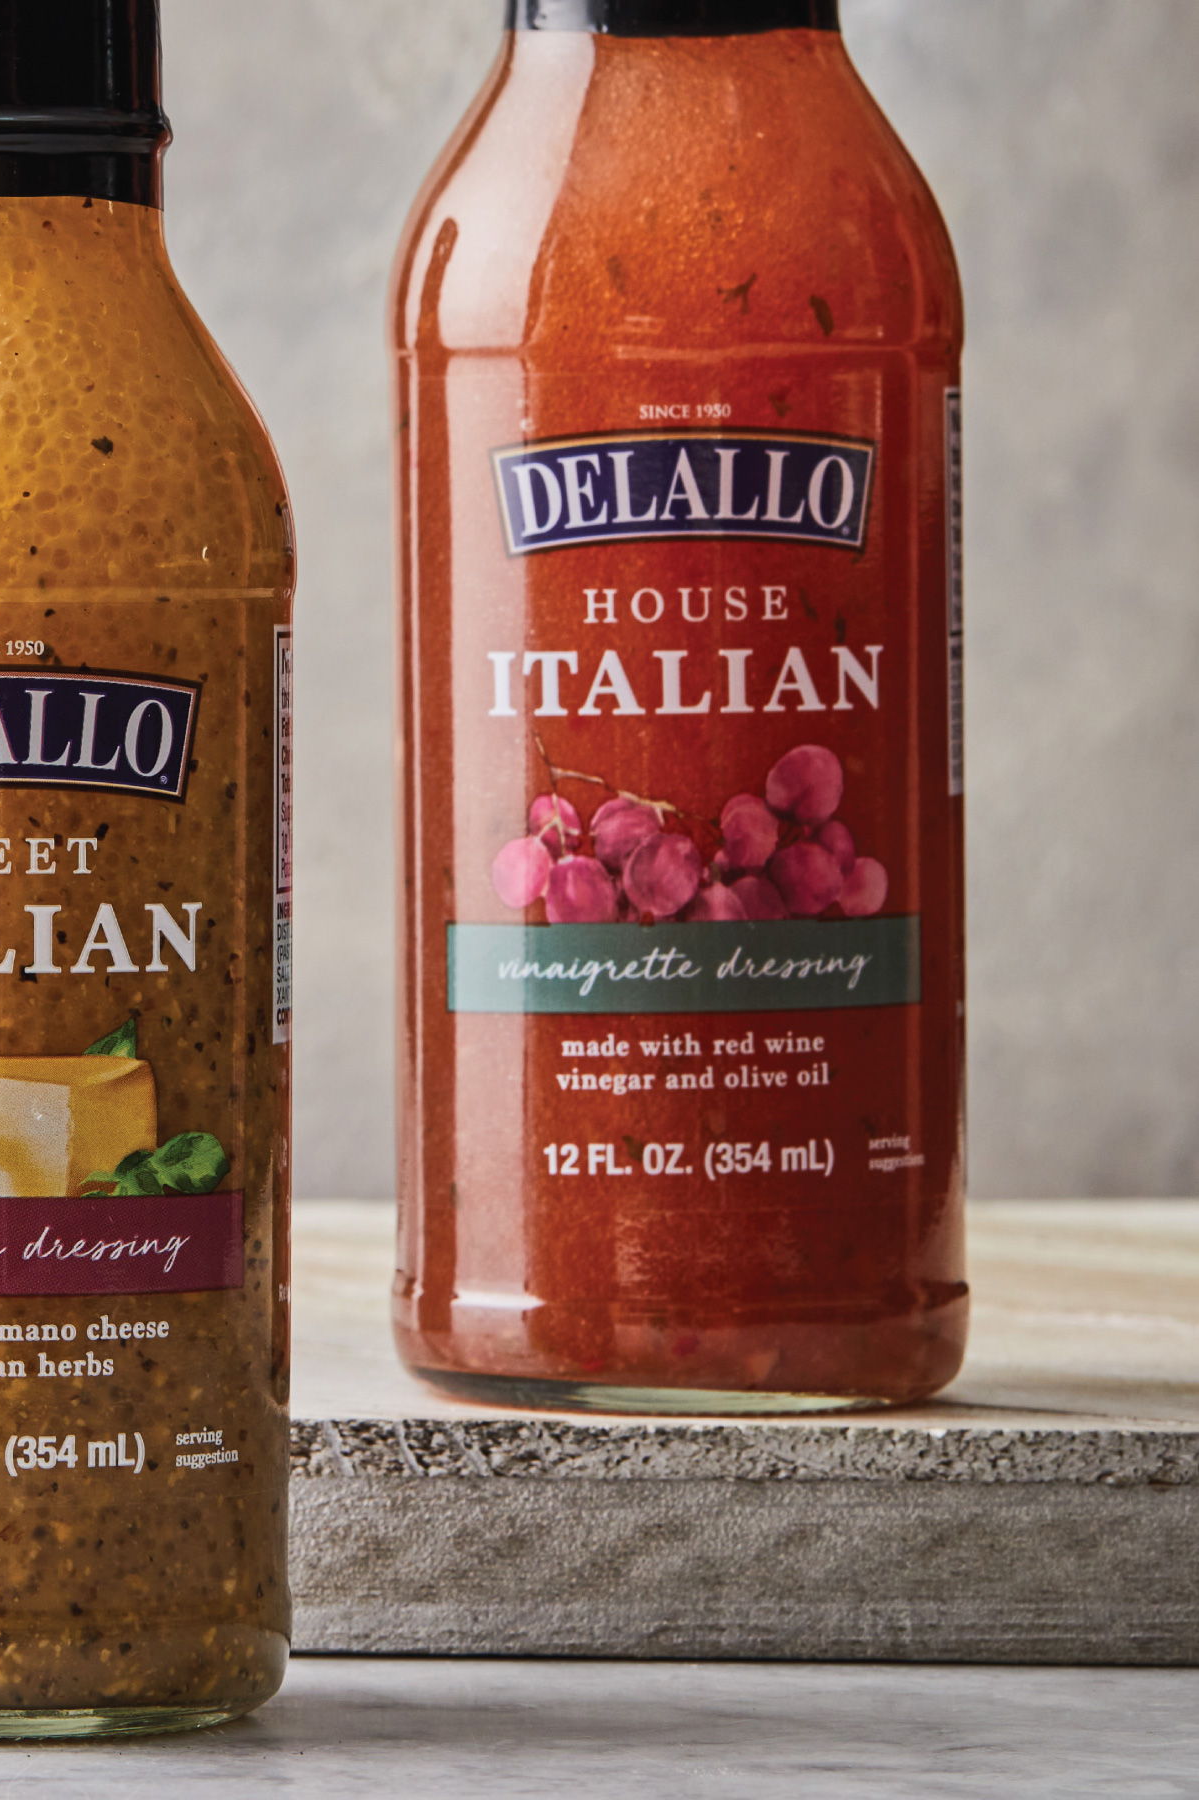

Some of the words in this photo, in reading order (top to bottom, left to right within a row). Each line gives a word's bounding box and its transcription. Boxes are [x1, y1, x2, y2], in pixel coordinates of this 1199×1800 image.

[639, 404, 690, 419] SINCE
[697, 403, 731, 418] 1950
[511, 448, 854, 537] DELALLO
[582, 586, 789, 623] HOUSE
[5, 640, 44, 655] 1950
[487, 645, 883, 716] ITALIAN
[498, 947, 701, 996] vinaigrette
[717, 947, 871, 990] dressing
[561, 1035, 629, 1057] made
[639, 1034, 701, 1056] with
[713, 1033, 755, 1054] red
[766, 1032, 825, 1054] wine
[556, 1067, 655, 1095] vinegar
[666, 1066, 714, 1089] and
[724, 1064, 788, 1088] olive
[798, 1062, 830, 1086] oil
[543, 1143, 579, 1175] 12
[588, 1143, 633, 1175] FL.
[643, 1142, 693, 1175] OZ.
[704, 1141, 771, 1179] (354
[781, 1139, 834, 1176] mL)
[22, 1226, 190, 1272] dressing
[86, 1316, 170, 1340] cheese
[38, 1353, 115, 1377] herbs
[176, 1426, 223, 1445] serving
[4, 1435, 77, 1476] (354
[87, 1432, 145, 1474] mL)
[176, 1447, 239, 1469] suggestion
